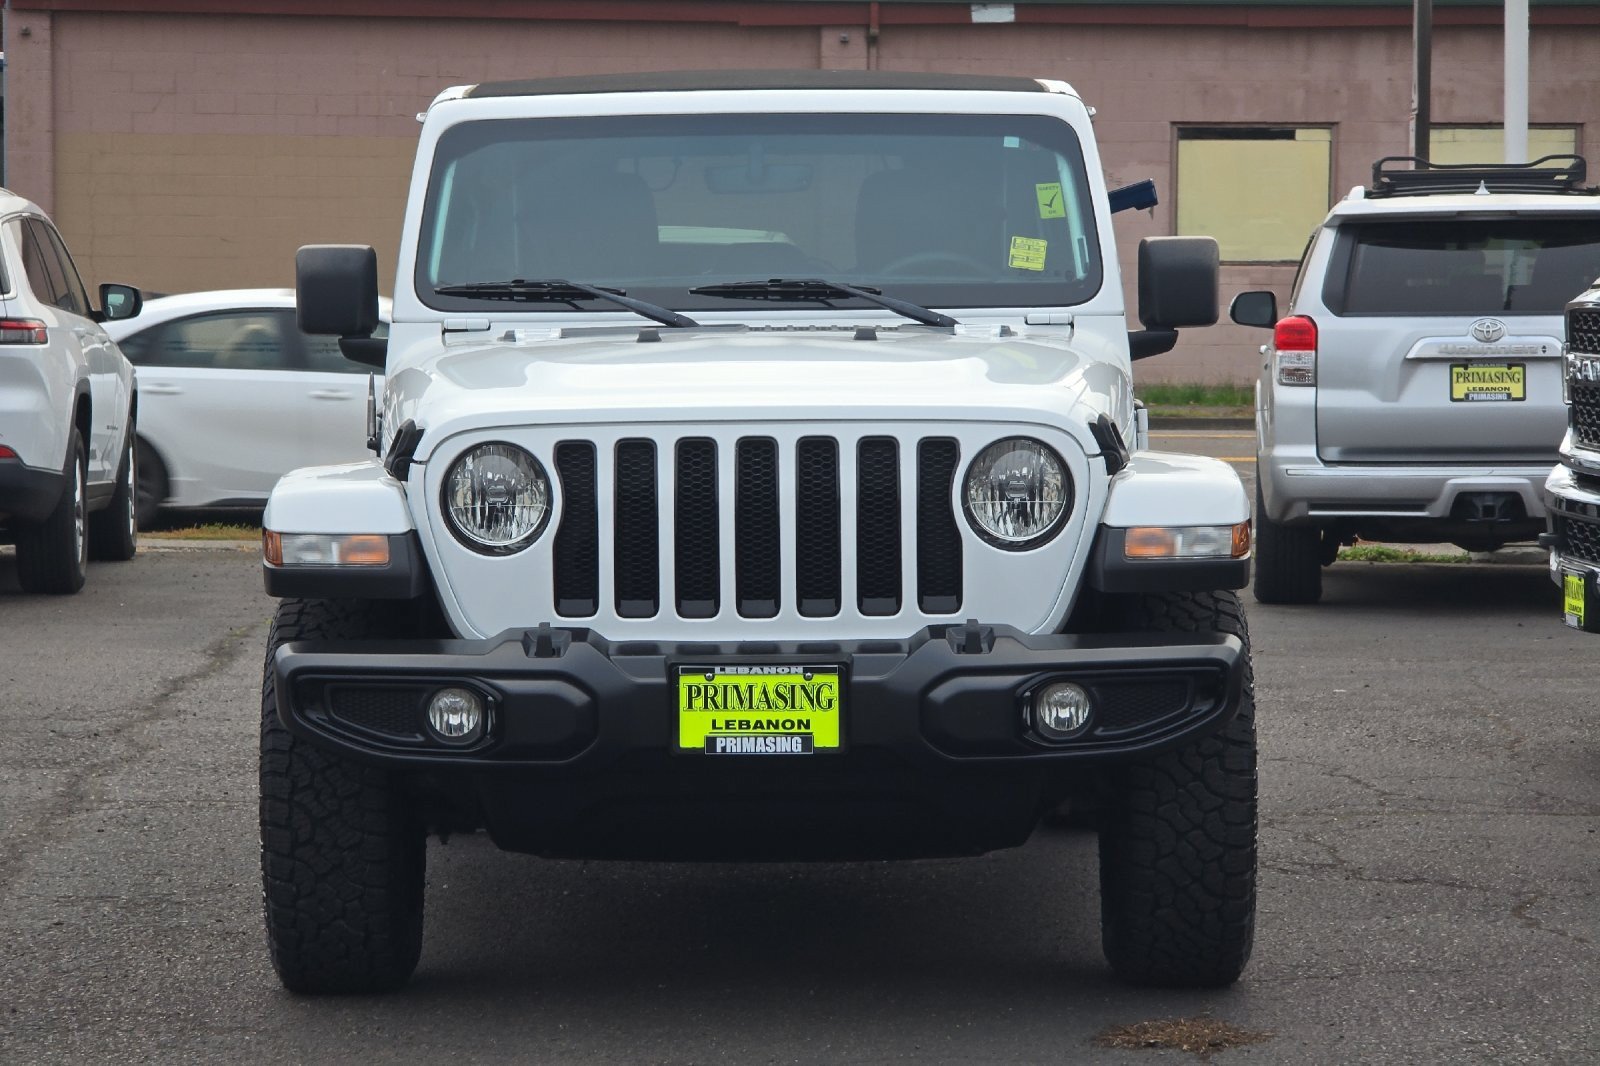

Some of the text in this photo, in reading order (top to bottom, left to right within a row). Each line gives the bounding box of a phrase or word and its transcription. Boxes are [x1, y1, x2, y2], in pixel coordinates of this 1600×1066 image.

[1455, 371, 1521, 384] PRIMASING
[1469, 392, 1507, 400] PRIMASING
[683, 682, 837, 712] PRIMASING
[712, 719, 811, 730] LEBANON
[716, 737, 802, 753] PRIMASING
